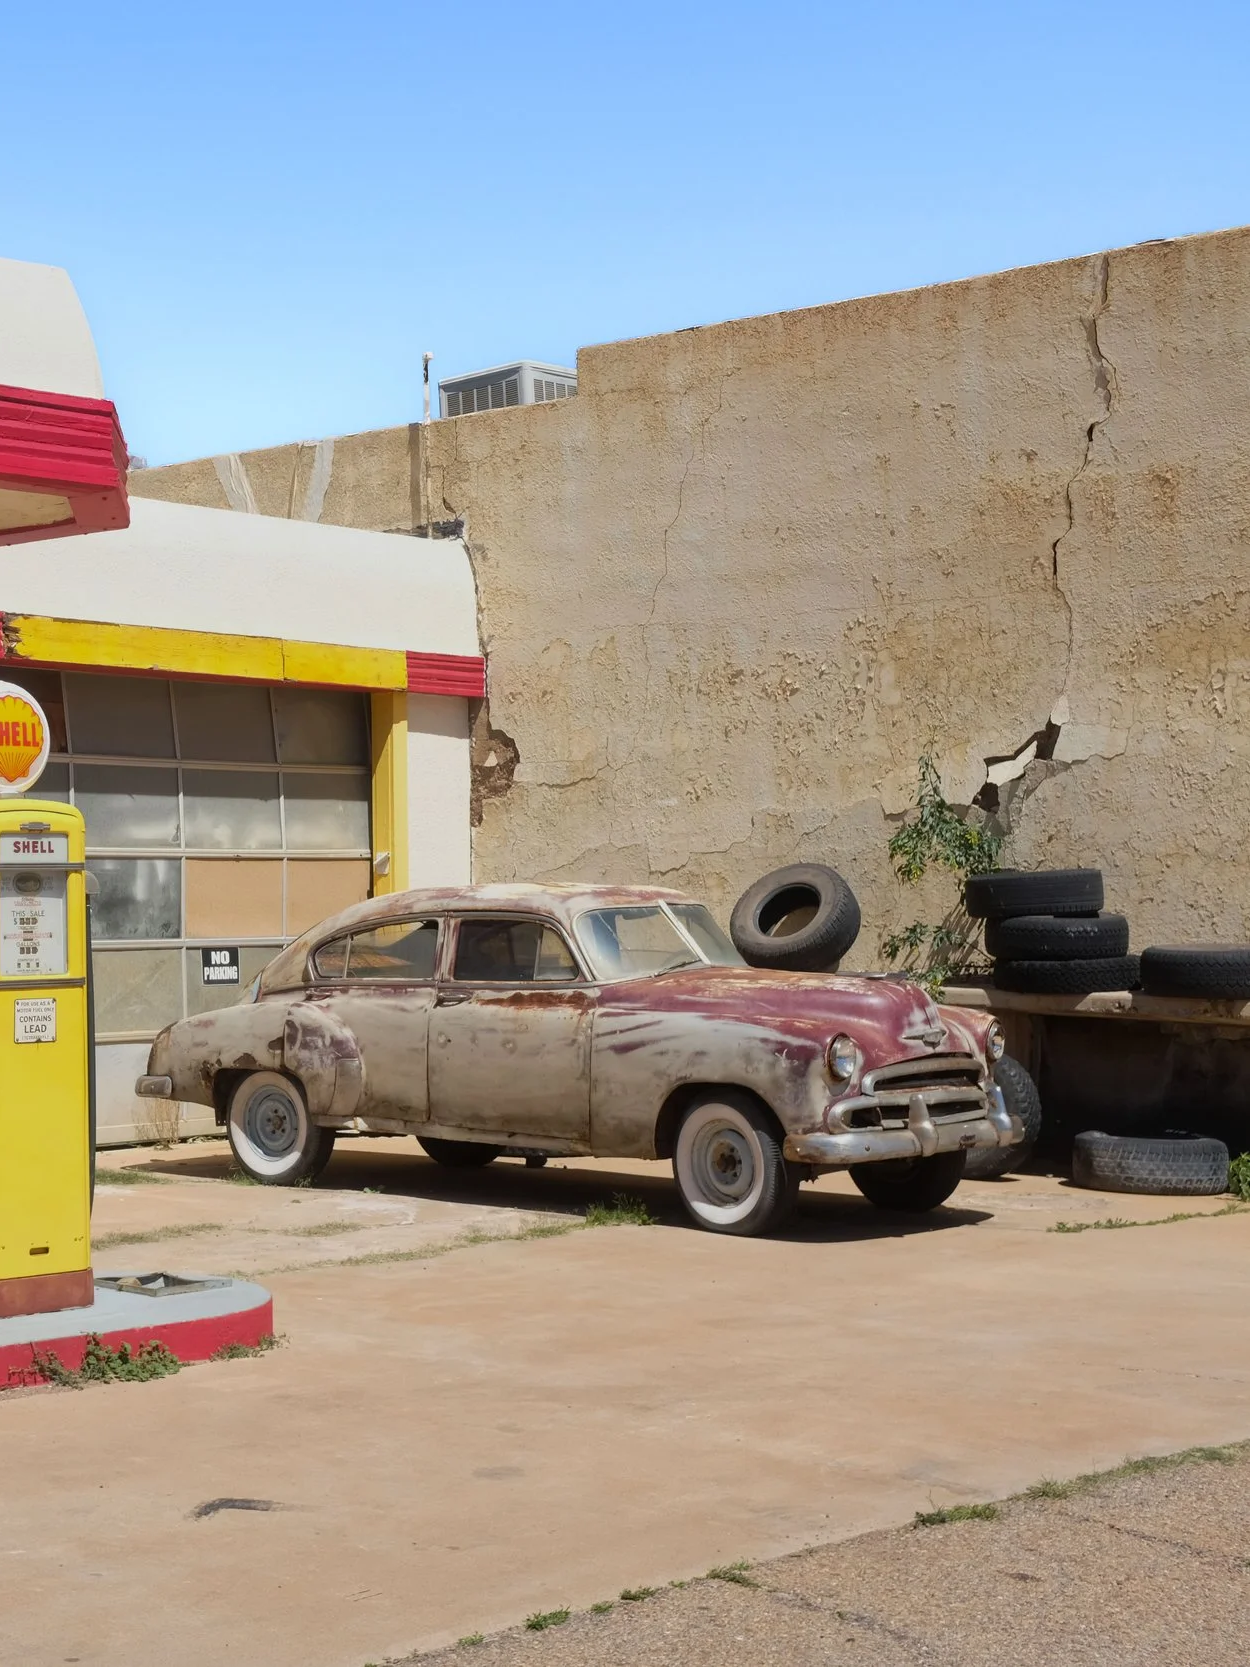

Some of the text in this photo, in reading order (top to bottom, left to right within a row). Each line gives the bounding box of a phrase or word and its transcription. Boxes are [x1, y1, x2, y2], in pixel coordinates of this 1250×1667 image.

[13, 840, 54, 854] SHELL
[29, 909, 45, 917] SALE
[211, 950, 230, 965] NO
[203, 966, 238, 980] PARKING
[19, 1014, 52, 1023] CONTAINS
[24, 1024, 47, 1033] LEAD
